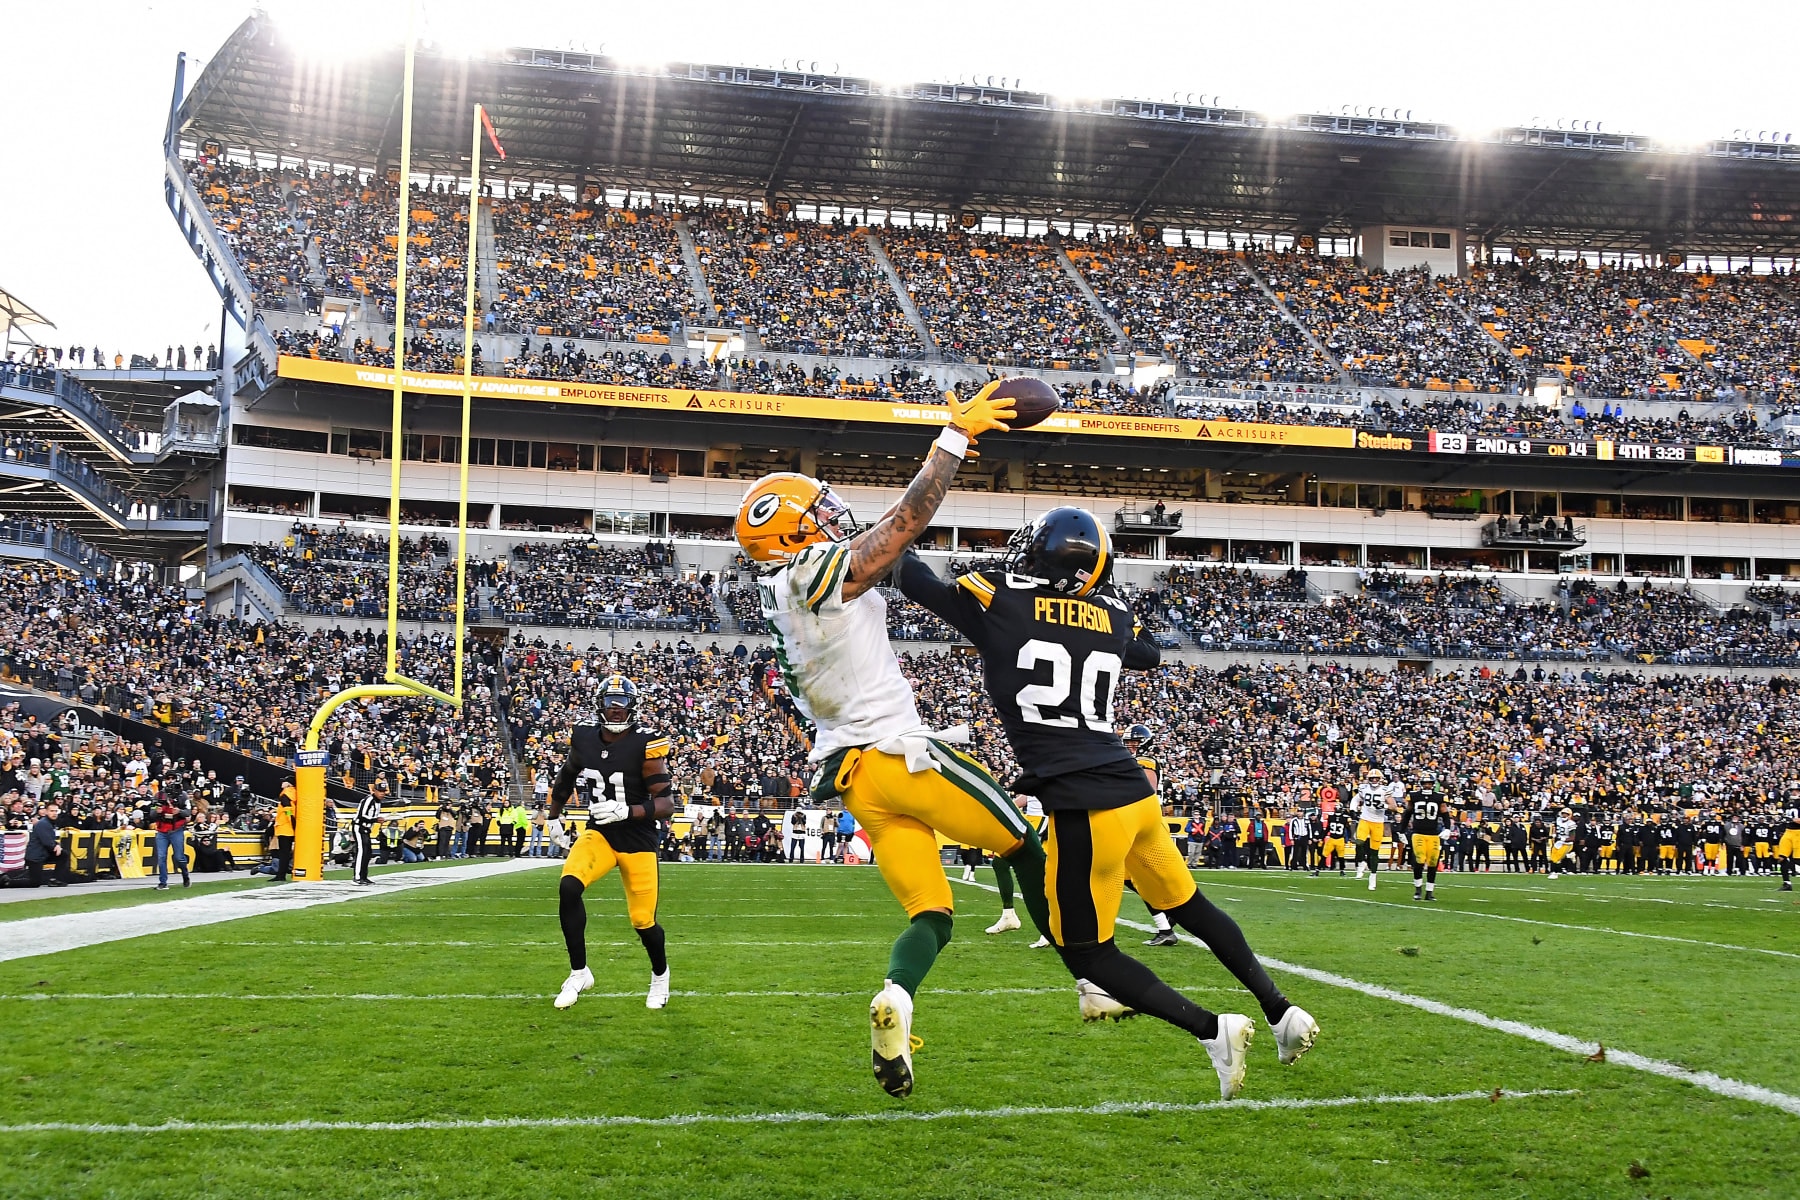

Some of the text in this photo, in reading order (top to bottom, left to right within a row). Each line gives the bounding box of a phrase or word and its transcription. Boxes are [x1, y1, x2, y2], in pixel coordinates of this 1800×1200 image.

[355, 370, 387, 384] YOUR
[387, 374, 479, 392] ETRAORDINAY
[561, 388, 616, 400] EMPLOYEE
[618, 391, 670, 403] BENEFITS.
[708, 398, 782, 411] ACRISURE
[891, 408, 921, 419] YOUR
[1081, 419, 1132, 431] EMPLOYEE
[1134, 422, 1182, 433] BENEFITS.
[1217, 428, 1284, 440] ACRISURE
[1357, 432, 1412, 450] Steelers
[1441, 437, 1462, 450] 23
[1519, 440, 1531, 454] 9
[1548, 444, 1566, 456] ON
[1568, 442, 1588, 456] 14
[1618, 444, 1685, 460] 4TH 3:28
[1034, 596, 1113, 634] PETERSON
[1016, 638, 1123, 734] 20
[582, 767, 627, 803] 31
[1300, 789, 1311, 801] 2
[1414, 801, 1439, 820] 50
[1329, 822, 1345, 835] 93
[1706, 825, 1720, 834] 94
